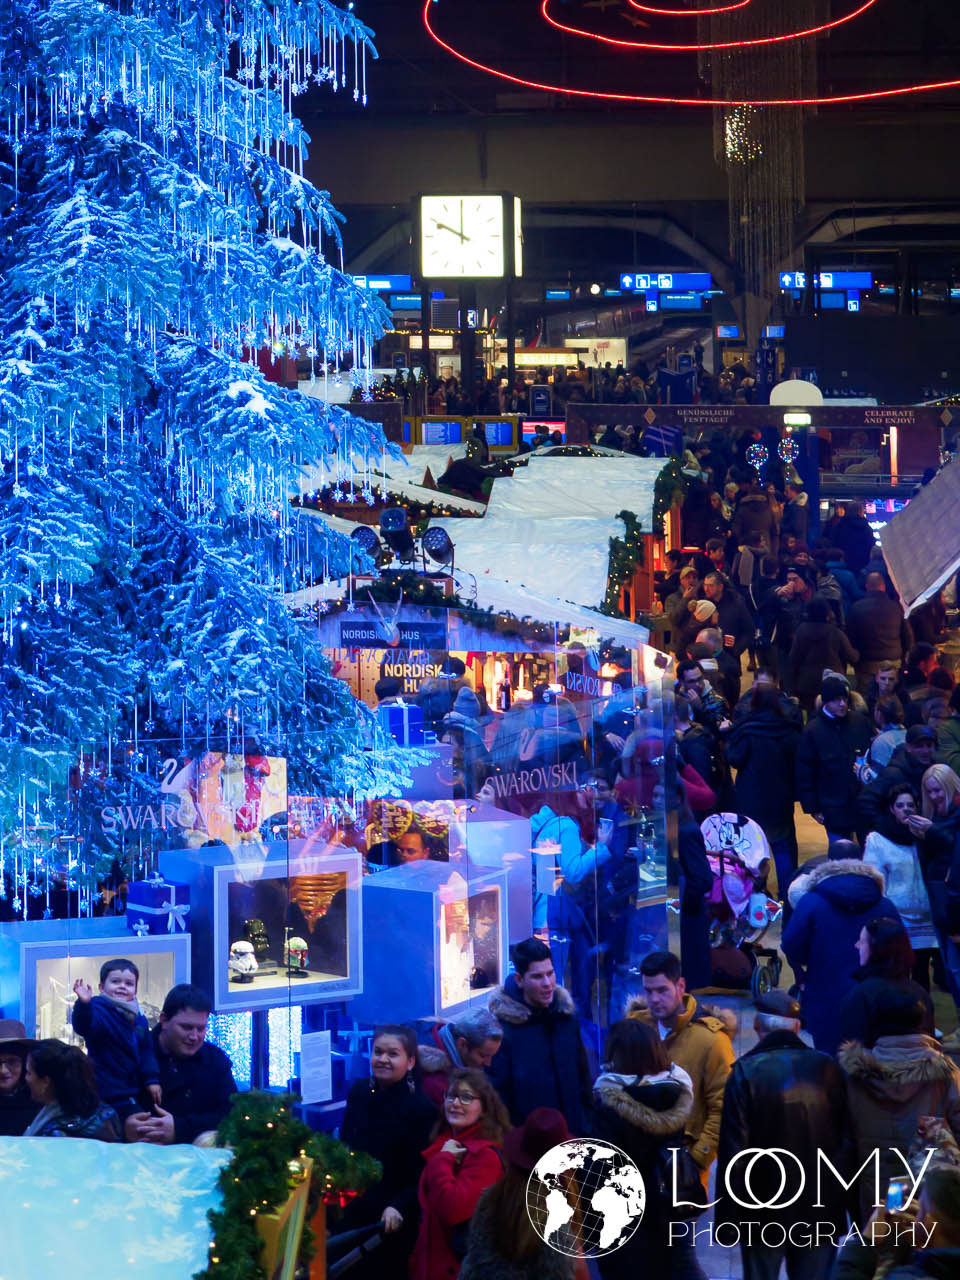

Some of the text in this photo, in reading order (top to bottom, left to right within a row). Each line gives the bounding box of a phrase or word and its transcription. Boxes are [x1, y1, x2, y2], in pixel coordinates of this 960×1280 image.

[864, 409, 915, 417] CELEBRATE
[401, 630, 420, 640] HUS
[384, 663, 442, 678] NORDISK
[100, 799, 261, 832] SWAROVSKI
